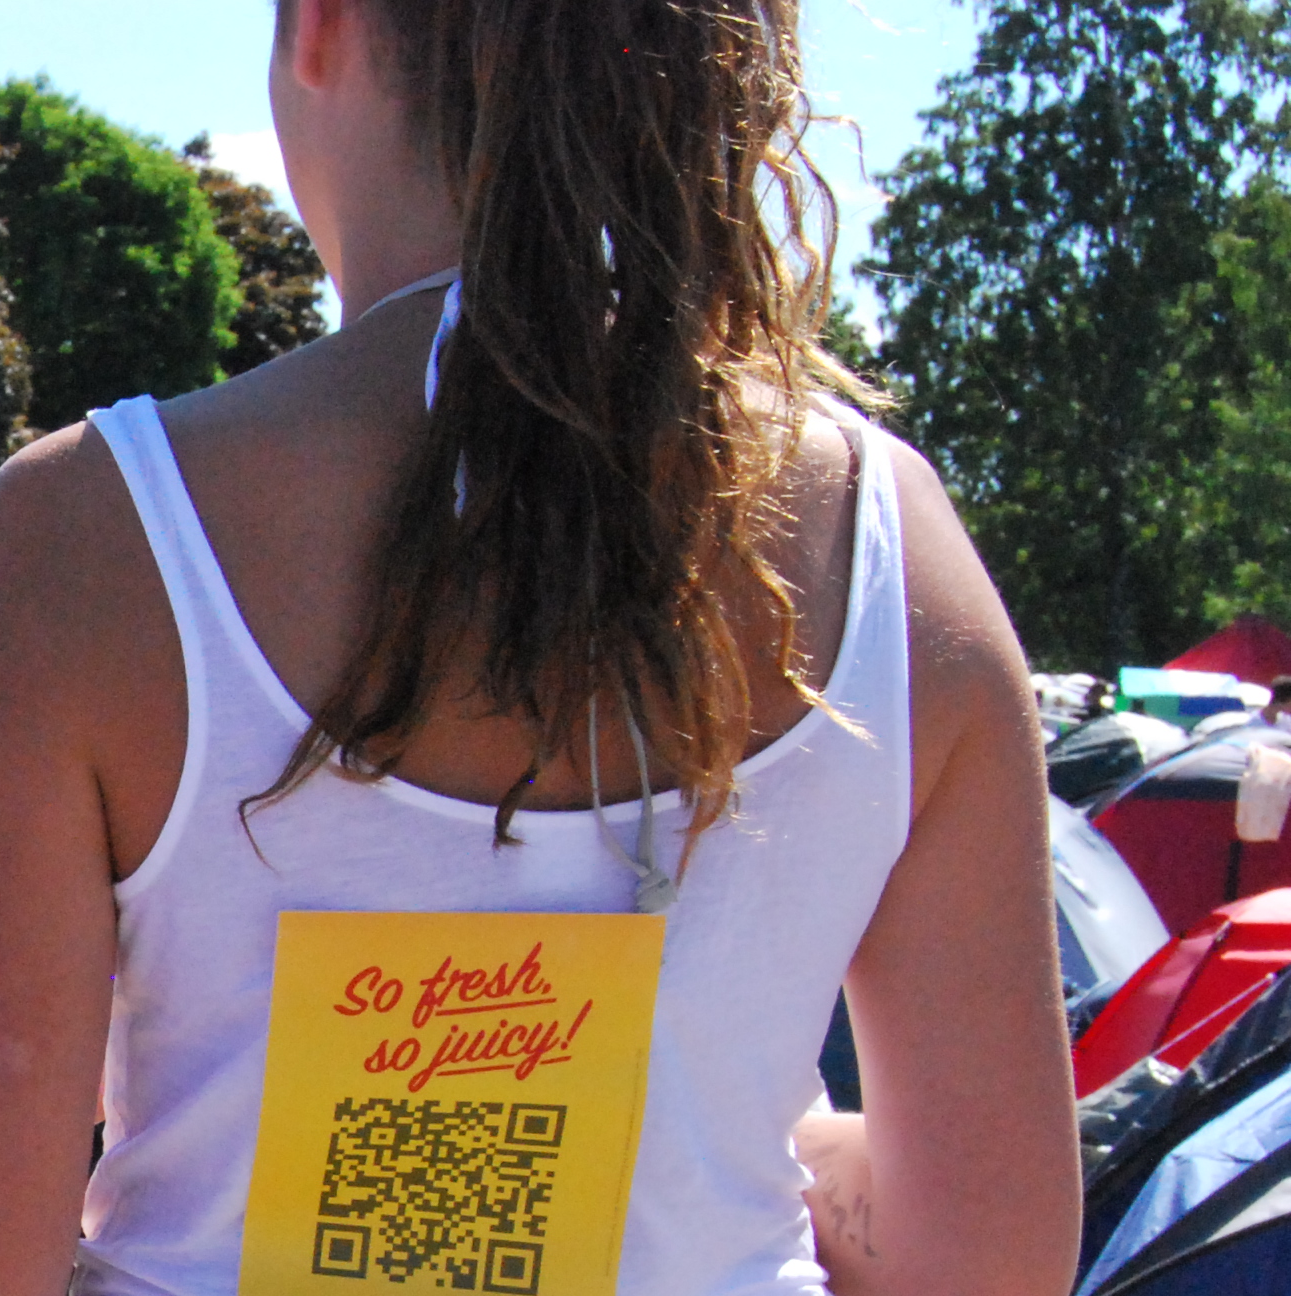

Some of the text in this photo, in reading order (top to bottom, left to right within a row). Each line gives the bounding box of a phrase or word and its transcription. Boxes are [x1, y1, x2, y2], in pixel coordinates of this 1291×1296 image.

[333, 965, 405, 1017] So
[362, 998, 594, 1094] so juicy!
